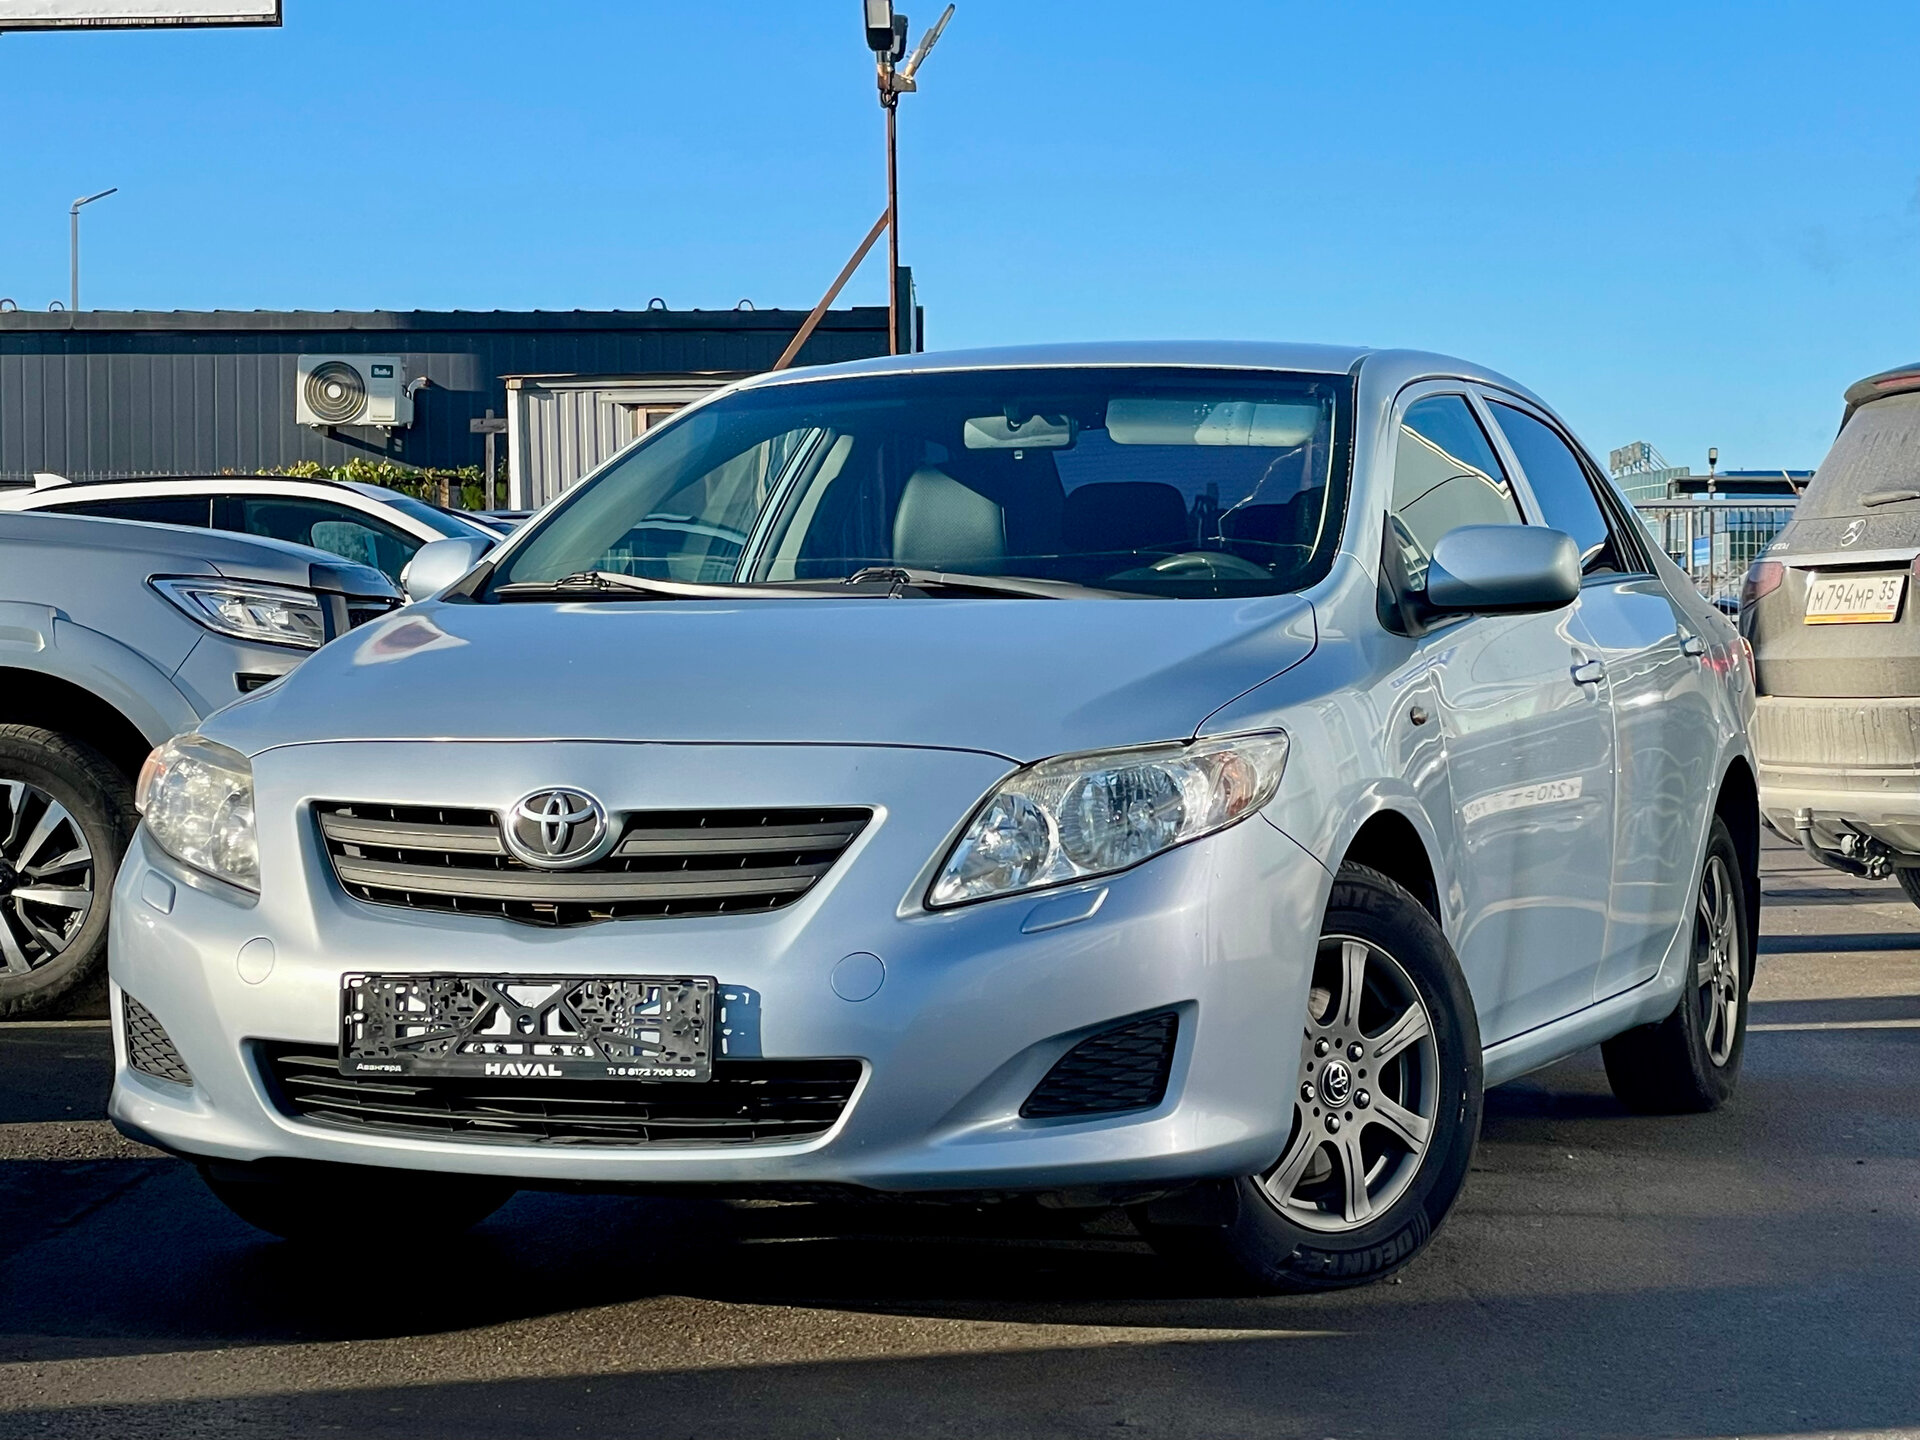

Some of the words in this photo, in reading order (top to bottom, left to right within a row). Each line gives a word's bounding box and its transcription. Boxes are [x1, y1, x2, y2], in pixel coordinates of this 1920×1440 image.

[1879, 580, 1897, 601] 35
[356, 1062, 402, 1073] Авангард
[484, 1062, 563, 1077] HAVAL
